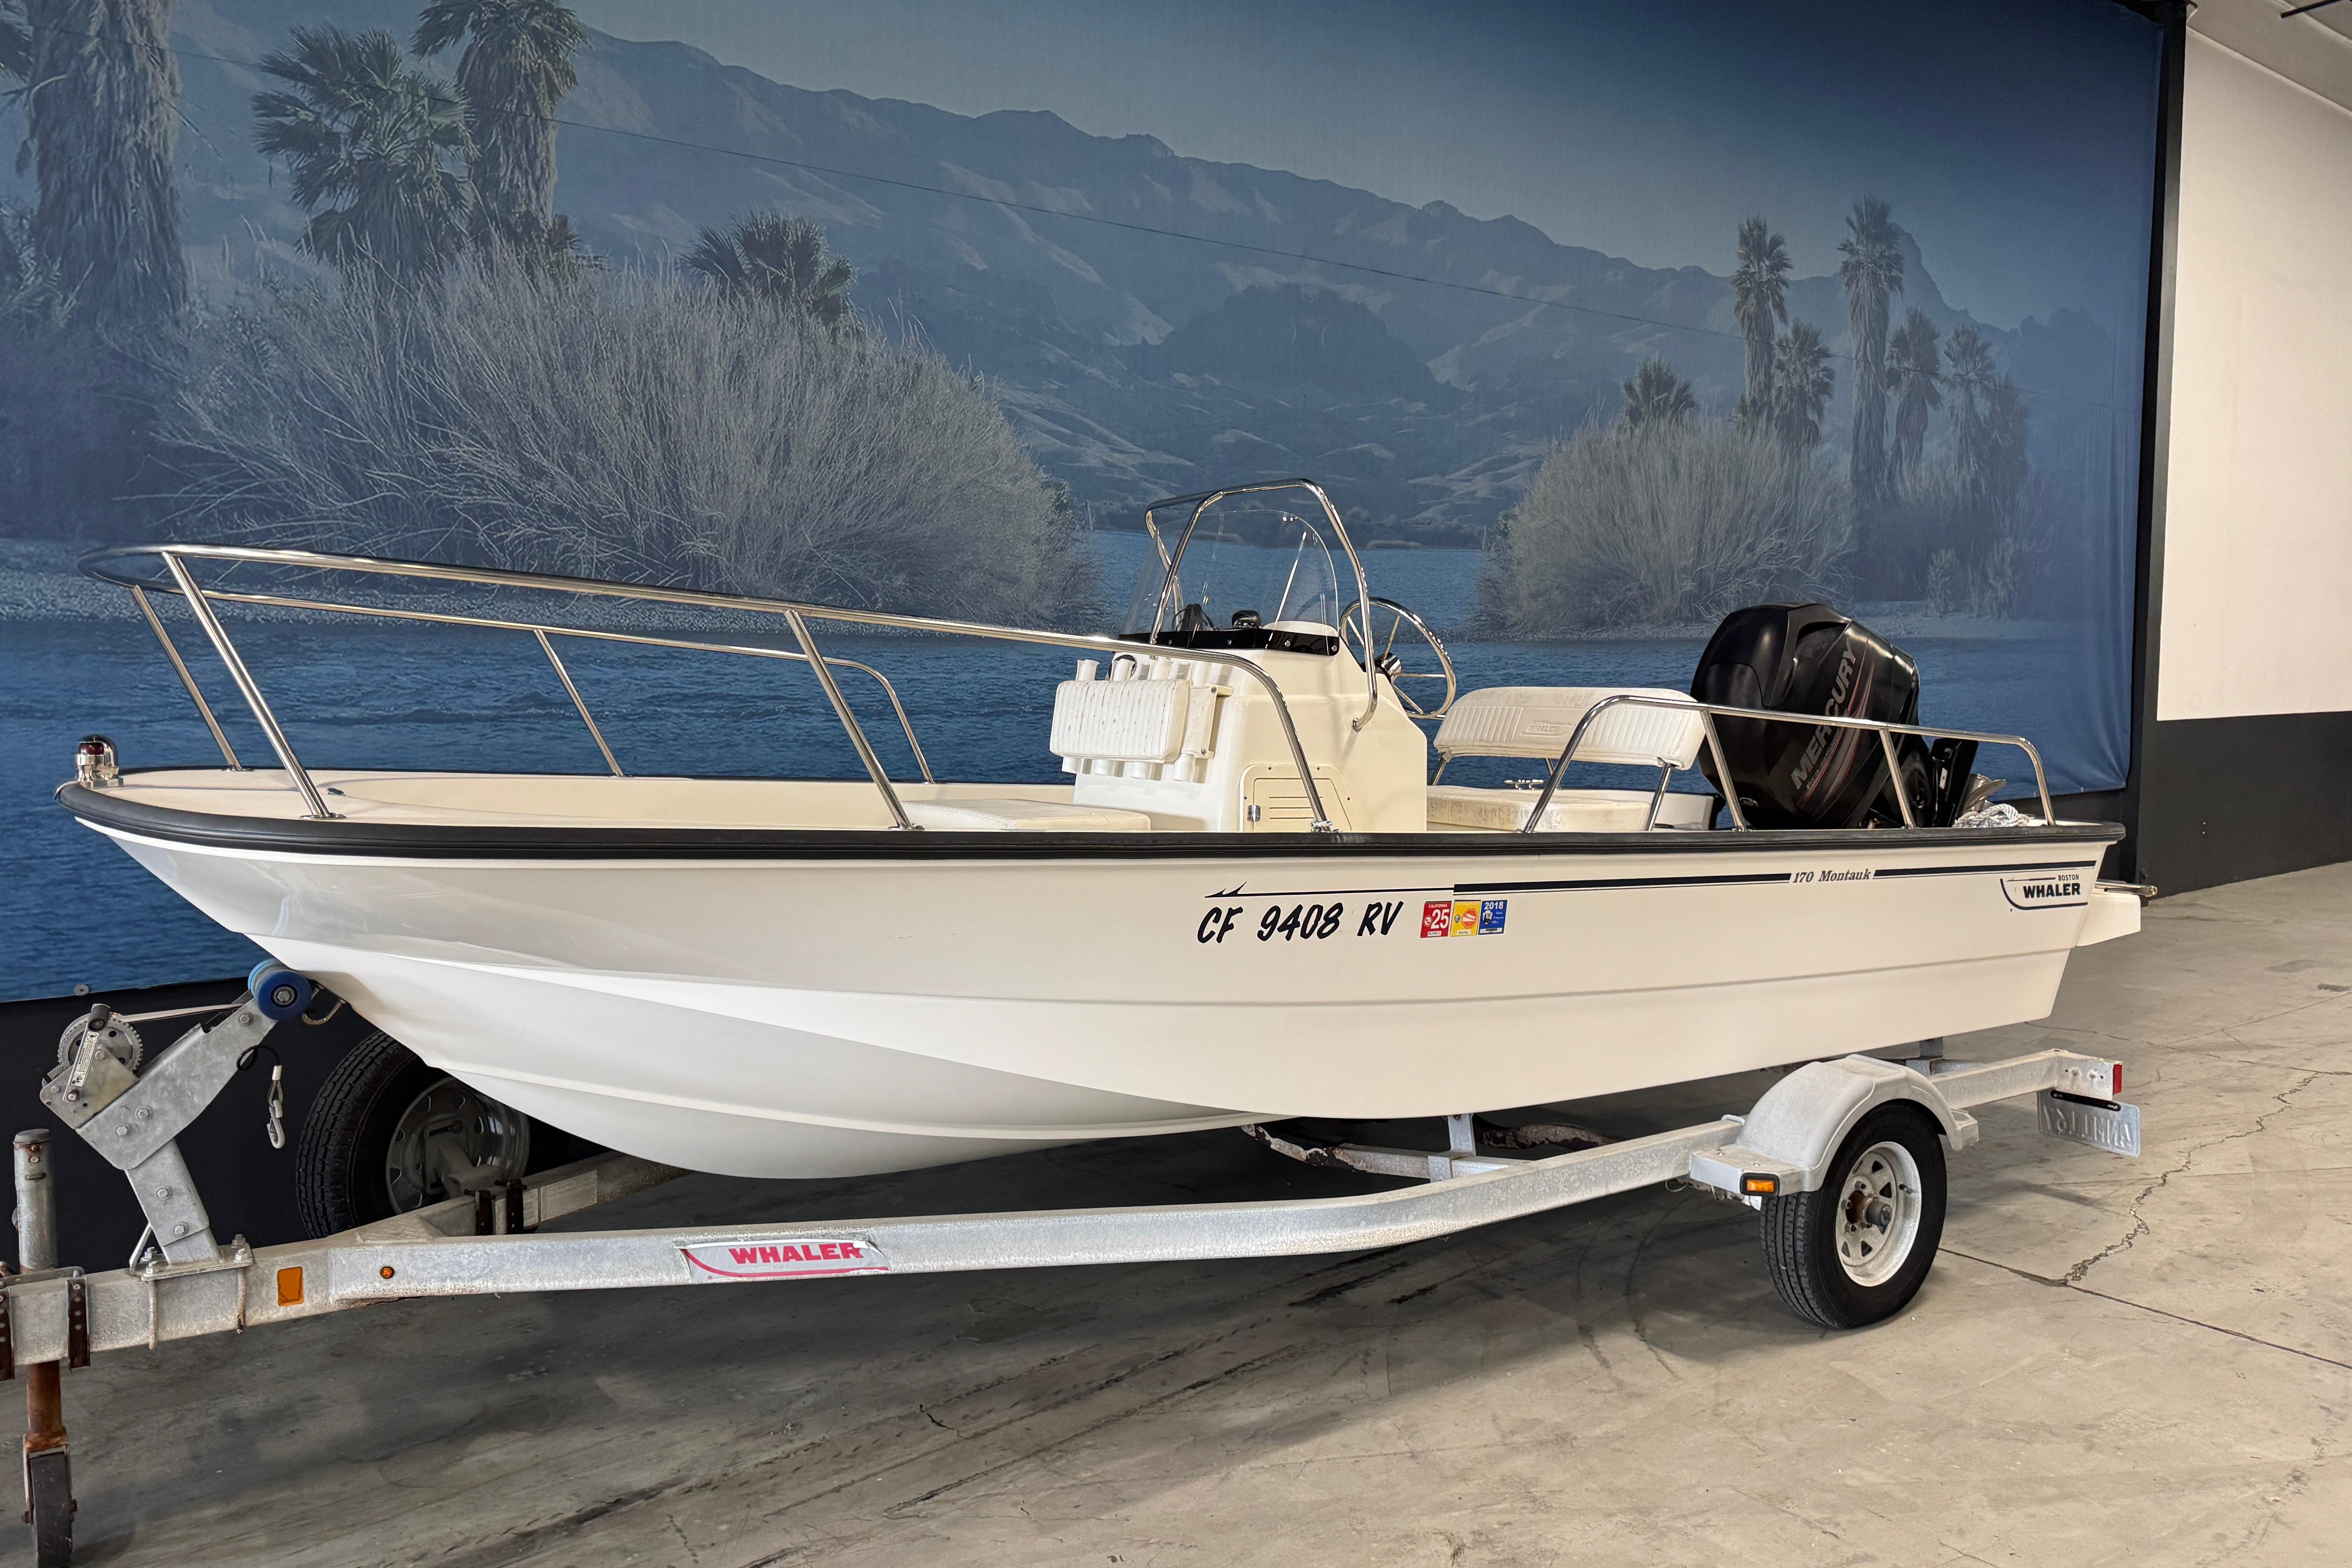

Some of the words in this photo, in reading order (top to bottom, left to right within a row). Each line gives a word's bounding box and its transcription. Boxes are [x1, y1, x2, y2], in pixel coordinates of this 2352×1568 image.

[1791, 638, 1856, 790] MERCURY
[1793, 871, 1814, 883] 170
[1818, 868, 1871, 882] Montauk
[2023, 882, 2081, 898] WHALER
[1484, 901, 1503, 910] 2018
[1197, 906, 1243, 943] CF
[1257, 903, 1343, 941] 9408
[1357, 901, 1404, 936] RV
[1430, 909, 1449, 929] 25
[728, 1243, 863, 1264] WHALER
